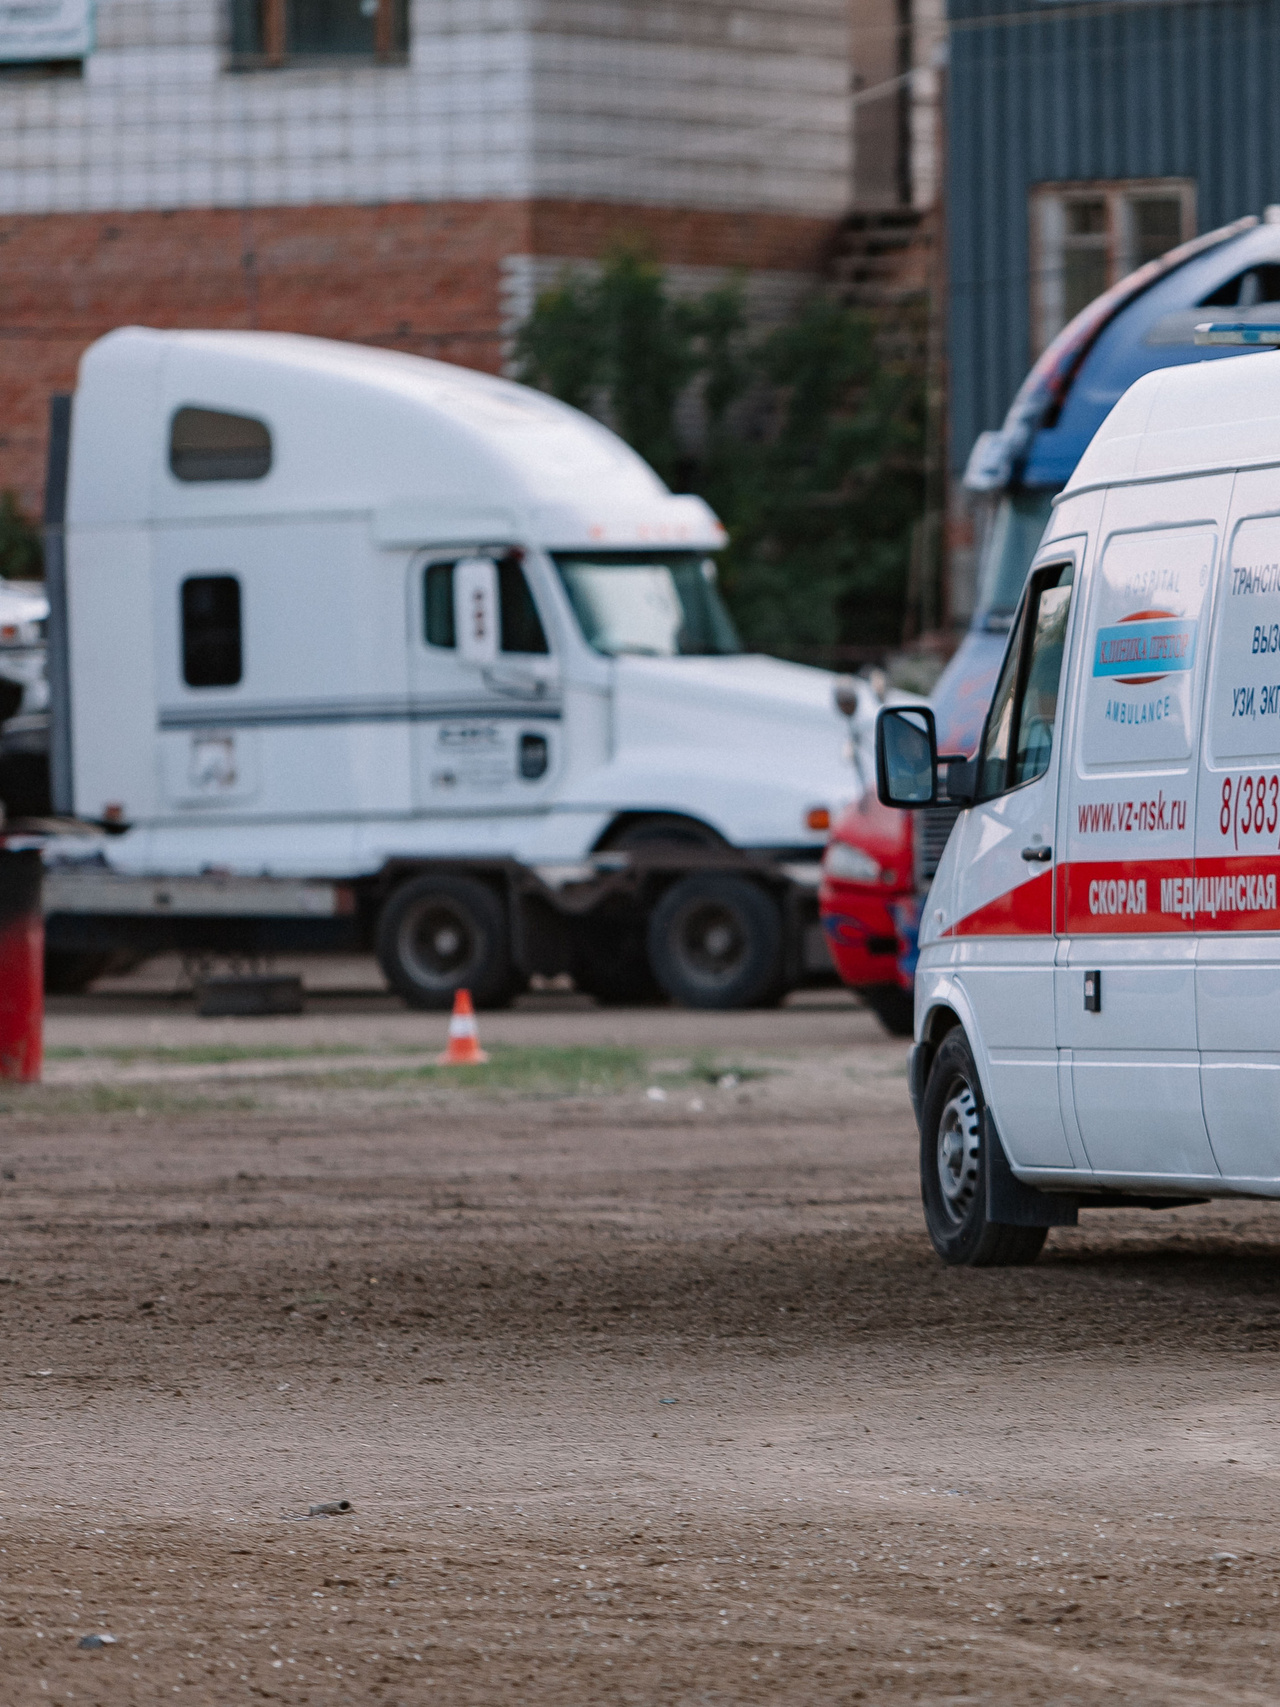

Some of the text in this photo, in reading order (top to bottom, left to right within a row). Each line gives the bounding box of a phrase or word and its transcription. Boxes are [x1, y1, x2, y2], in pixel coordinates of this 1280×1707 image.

[1100, 633, 1190, 664] КЛИНИКА ПРЕТОР
[1105, 696, 1171, 725] AMBULANCE
[1232, 687, 1256, 721] УЗИ,
[1078, 790, 1186, 834] www.vz-nsk.ru
[1089, 878, 1147, 915] СКОРАЯ
[1160, 874, 1278, 920] МЕДИЦИНСКАЯ
